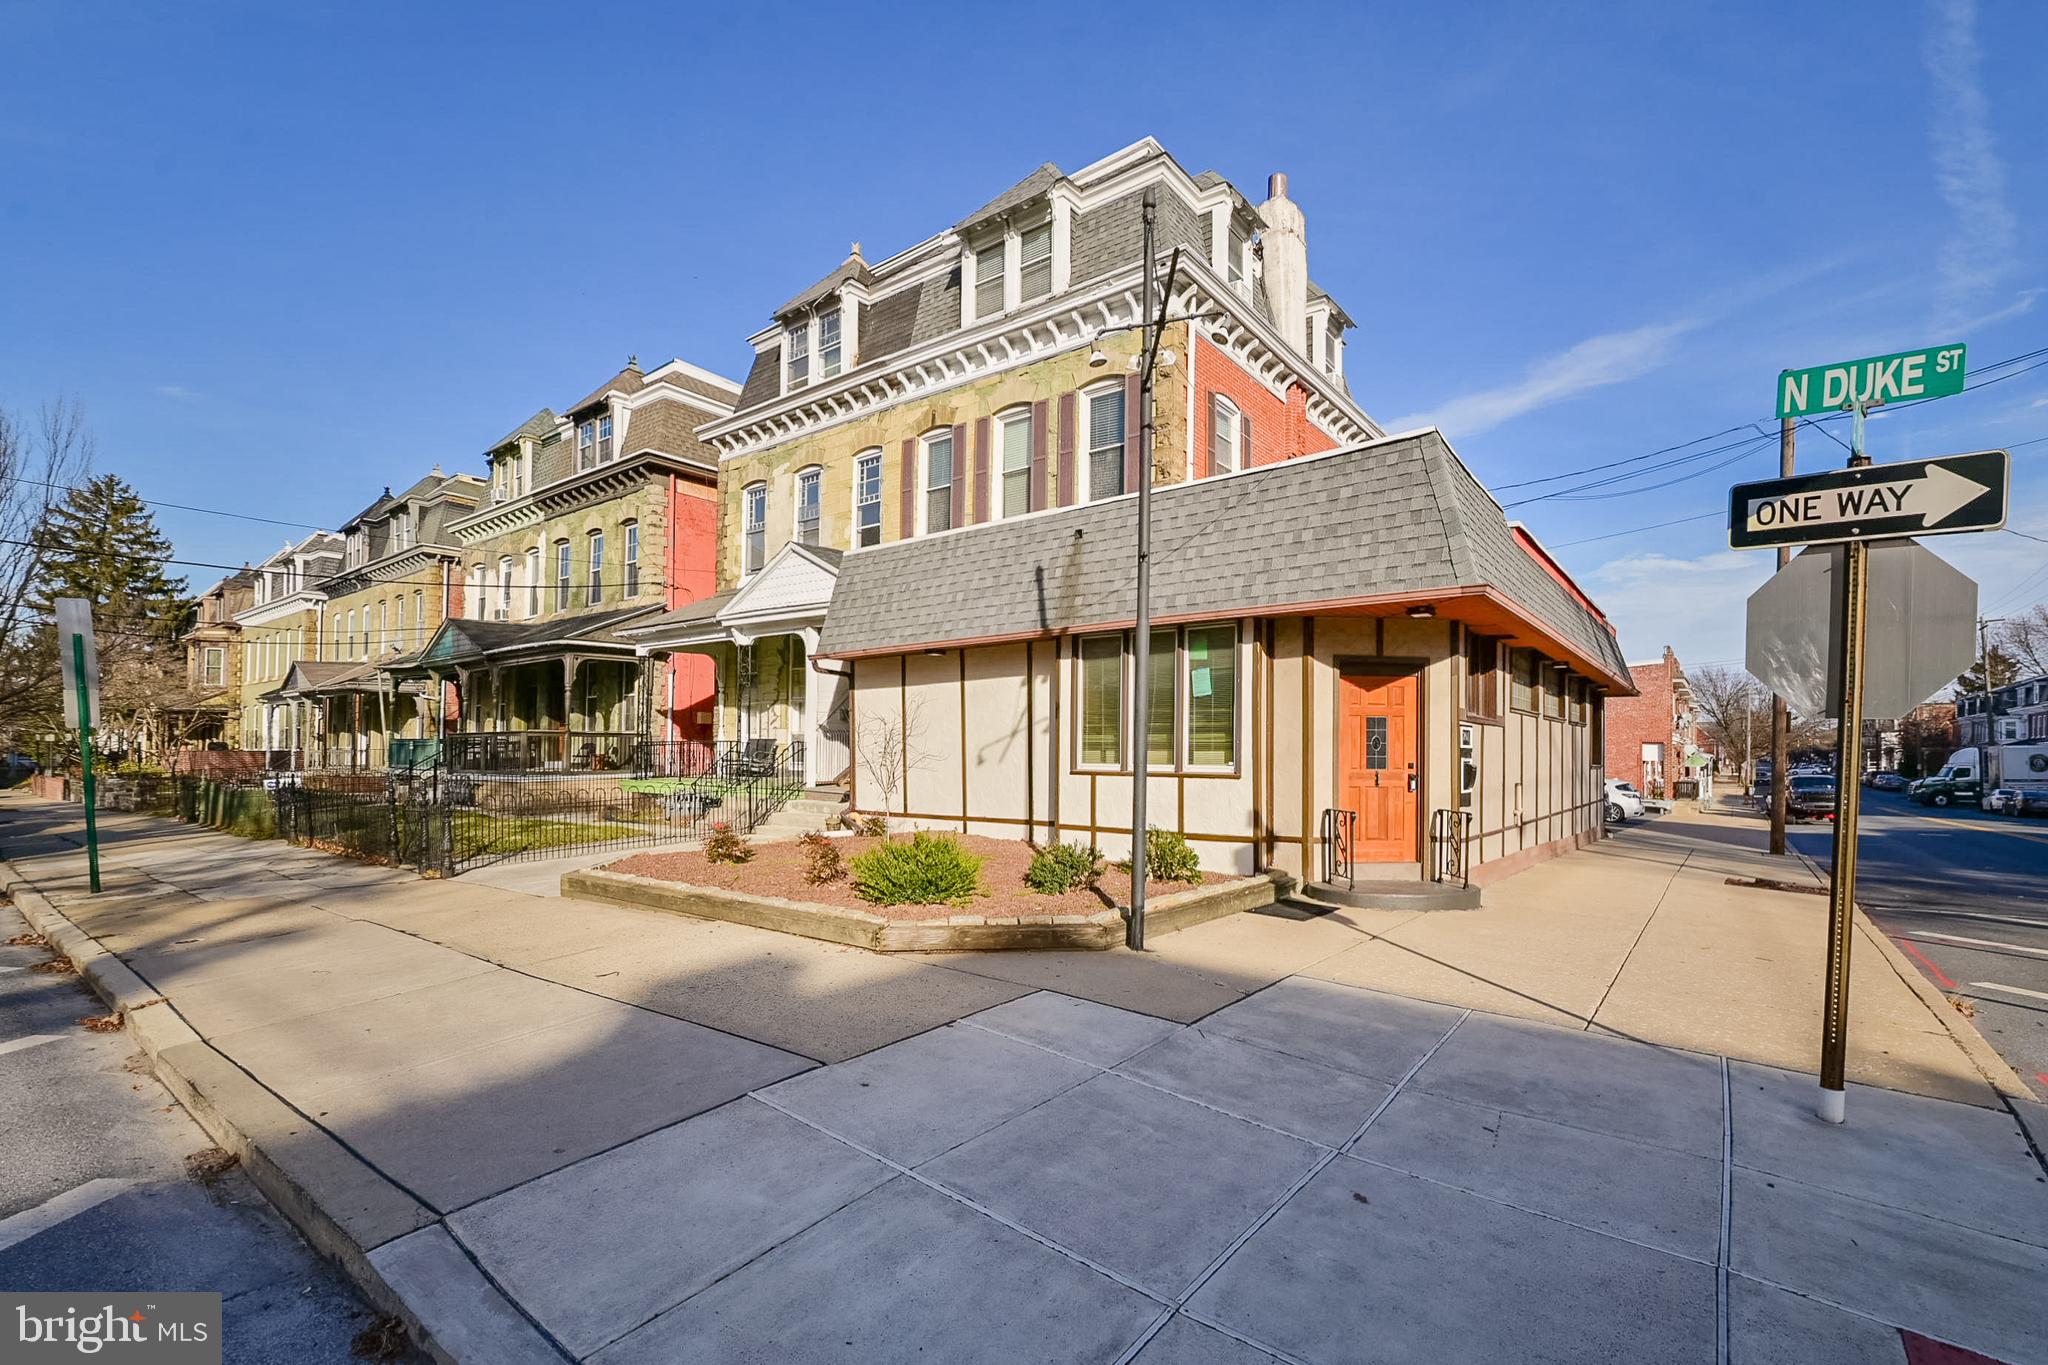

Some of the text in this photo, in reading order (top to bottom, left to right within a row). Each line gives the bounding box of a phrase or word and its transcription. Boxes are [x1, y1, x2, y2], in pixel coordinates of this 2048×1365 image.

[1783, 349, 1964, 413] N DUKE ST
[1756, 484, 1914, 526] ONE WAY
